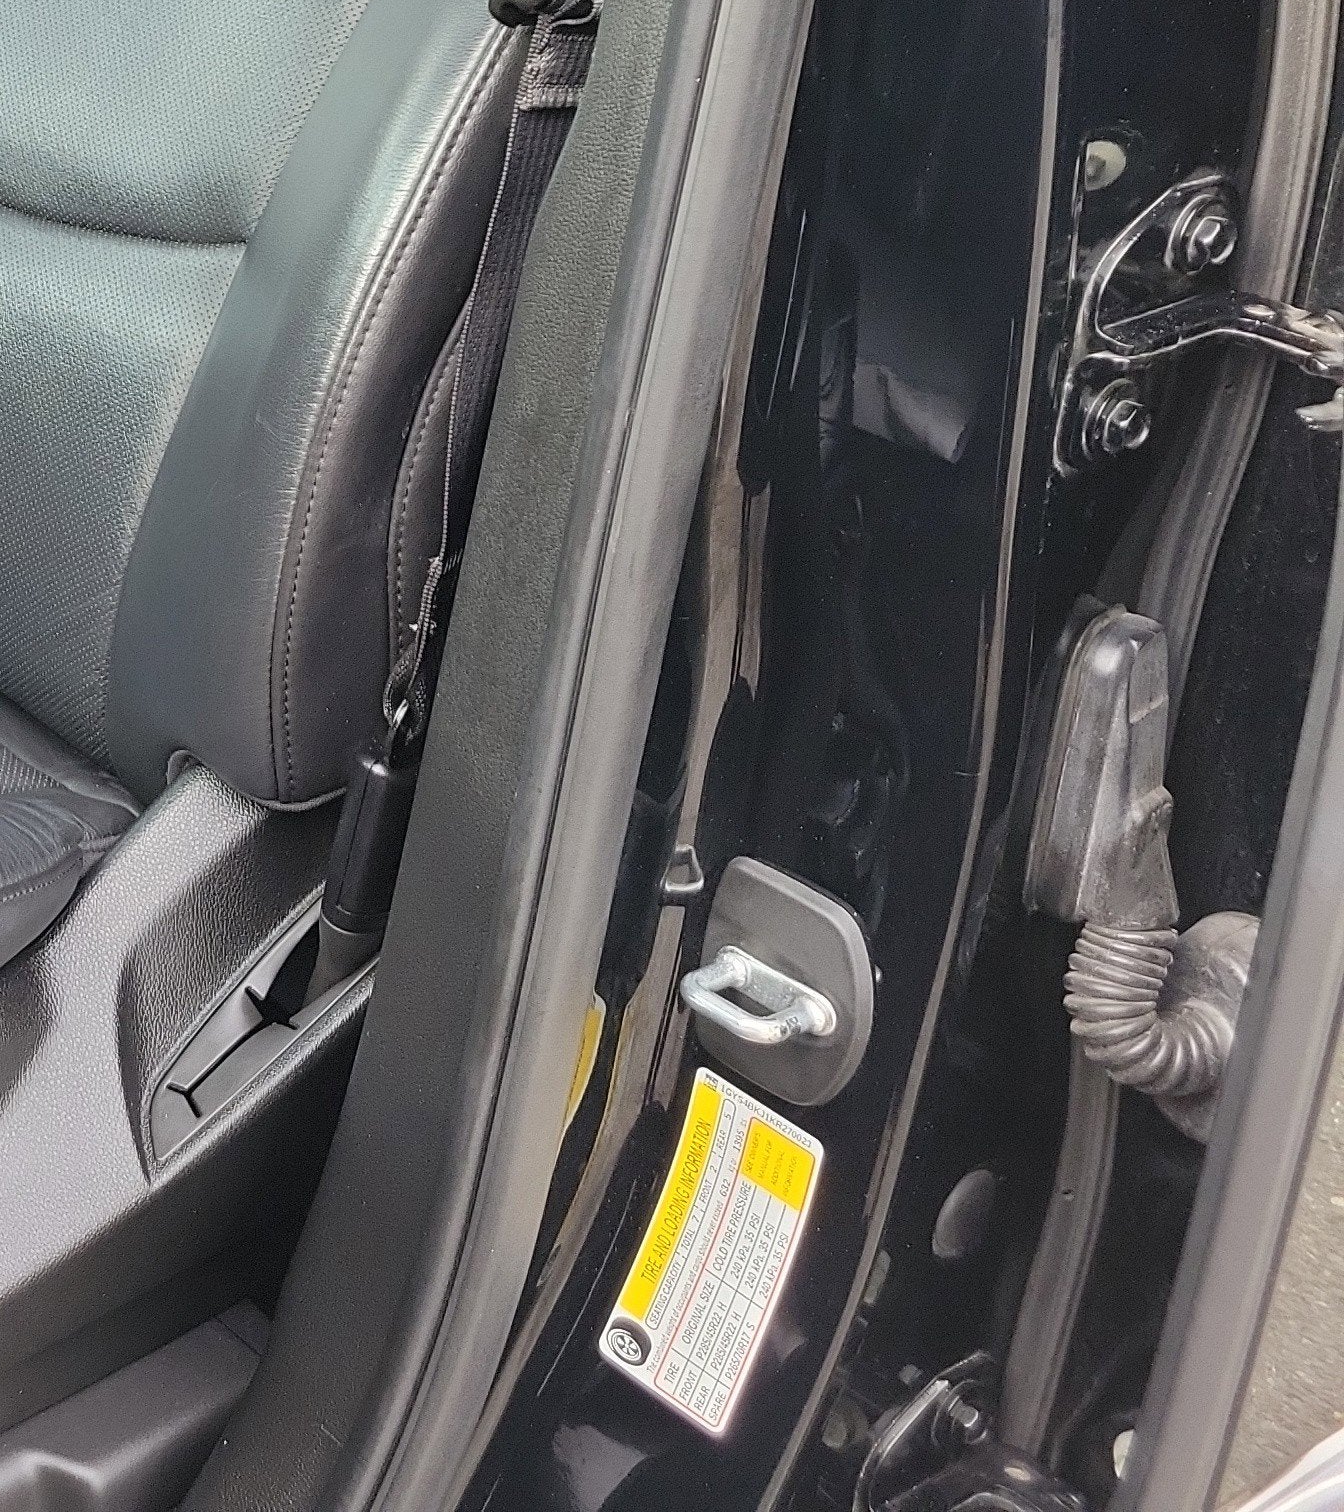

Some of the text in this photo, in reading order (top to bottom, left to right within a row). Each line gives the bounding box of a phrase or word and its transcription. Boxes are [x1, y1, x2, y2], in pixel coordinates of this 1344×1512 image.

[679, 1117, 712, 1190] INFORMATION
[719, 1177, 731, 1198] 632
[732, 1128, 745, 1152] 1395
[649, 1112, 732, 1325] SEATING CAPACITY TOTAL 7 FRONT 2 REAR 5
[660, 1186, 691, 1238] LOADING
[748, 1212, 761, 1230] PSI
[743, 1229, 755, 1243] 35
[763, 1222, 775, 1240] PSI
[777, 1231, 789, 1249] PSI
[651, 1233, 672, 1261] AND
[758, 1238, 769, 1253] 35
[772, 1248, 783, 1263] 35
[640, 1256, 663, 1285] TIRE
[664, 1181, 752, 1384] TIRE ORIGINAL SIZE COLD TIRE PRESSURE
[730, 1261, 743, 1279] 240
[745, 1270, 757, 1289] 240
[759, 1280, 772, 1299] 240
[716, 1301, 728, 1312] H
[731, 1311, 742, 1322] H
[695, 1311, 723, 1361] P285/45R22
[746, 1321, 756, 1332] S
[710, 1321, 737, 1371] P285/45R22
[725, 1331, 752, 1381] P265/70R17
[679, 1370, 698, 1401] FRONT
[693, 1385, 711, 1411] REAR
[708, 1390, 727, 1421] SPARE
